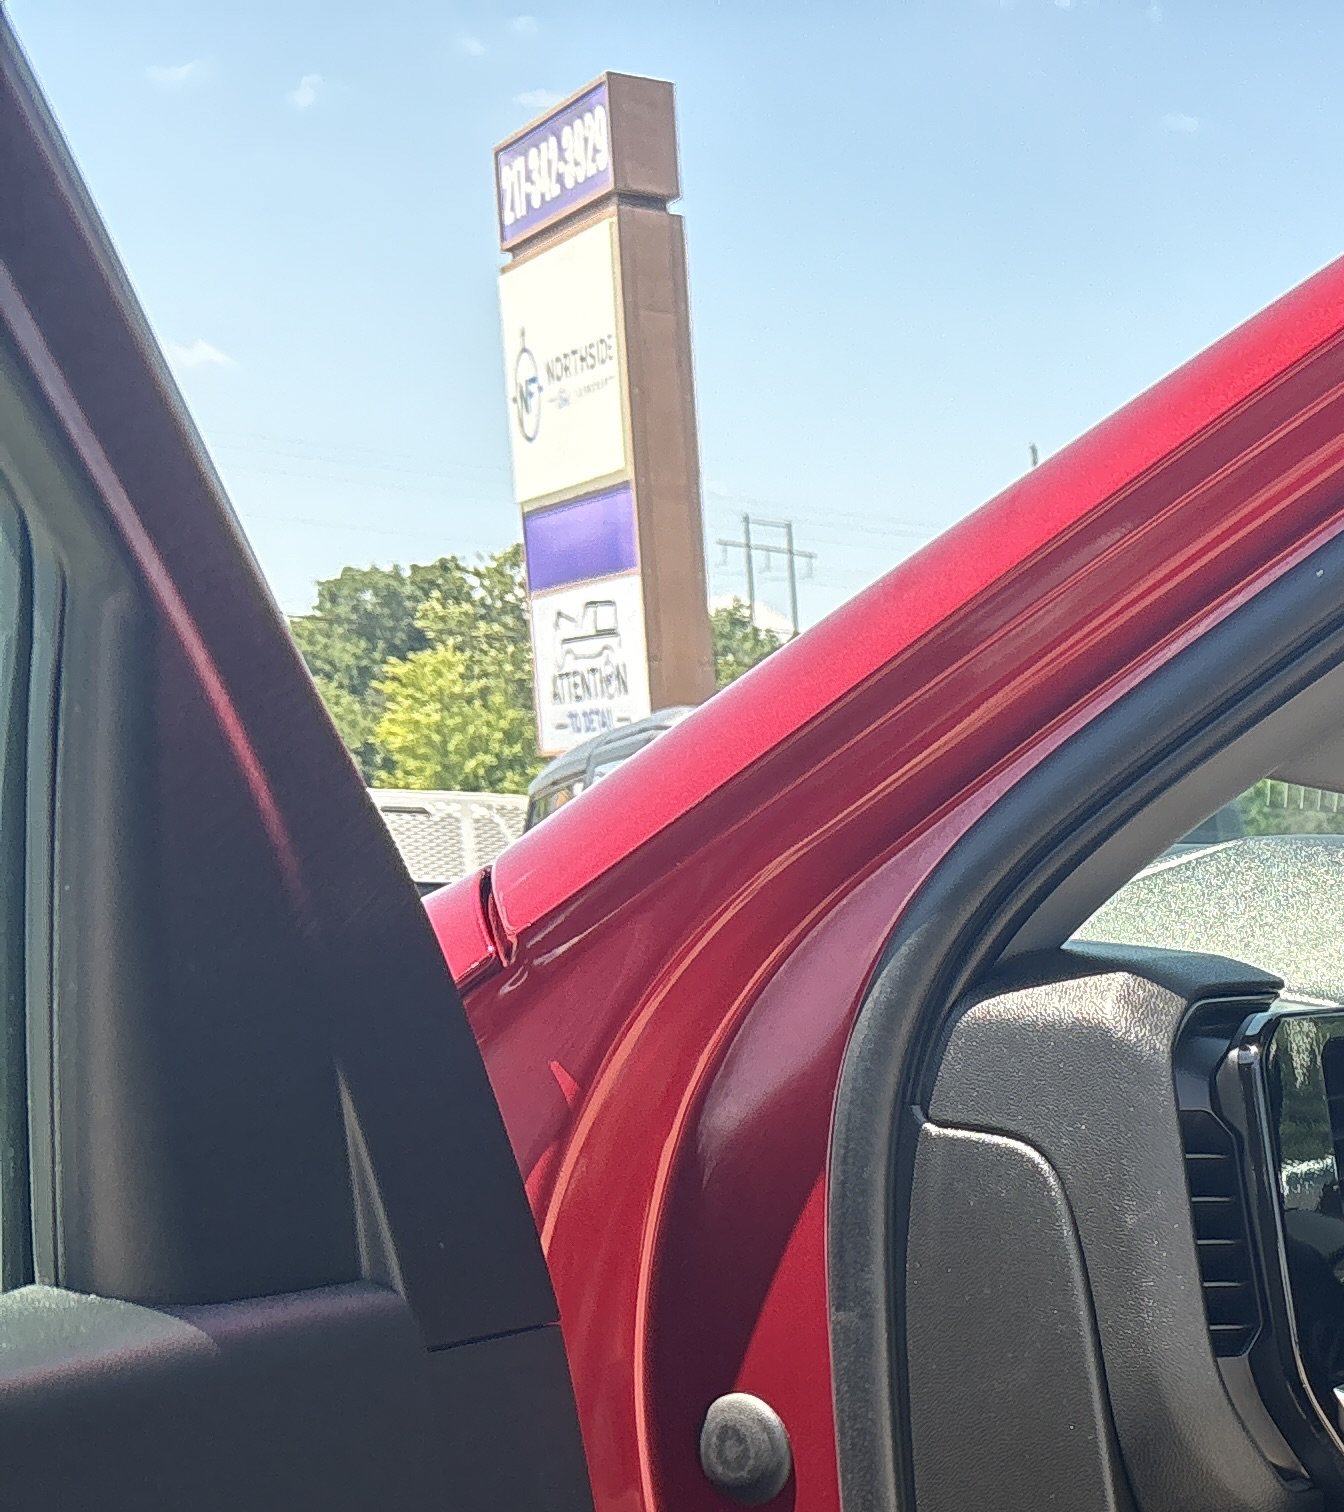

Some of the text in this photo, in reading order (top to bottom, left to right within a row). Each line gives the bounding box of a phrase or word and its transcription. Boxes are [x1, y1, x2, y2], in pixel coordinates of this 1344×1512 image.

[501, 105, 609, 226] 217-342-3929
[545, 333, 613, 384] NORTHSIDE
[552, 660, 629, 704] ATTENTION
